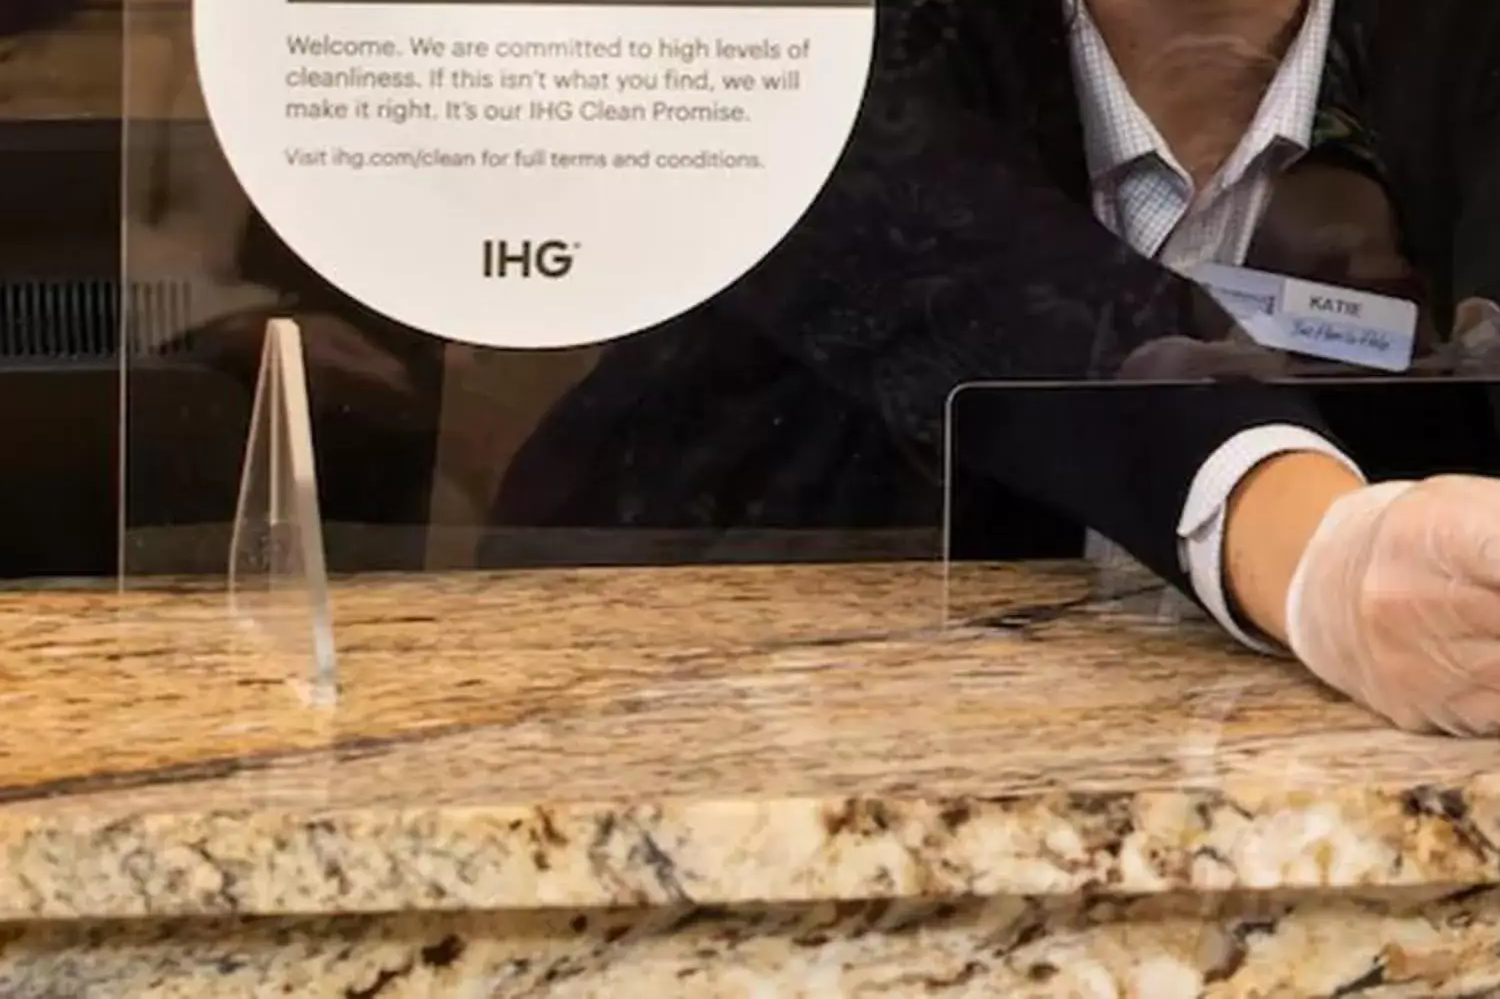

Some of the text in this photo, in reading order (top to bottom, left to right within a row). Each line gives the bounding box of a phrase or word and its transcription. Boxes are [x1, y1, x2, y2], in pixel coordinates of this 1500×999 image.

[286, 34, 810, 66] Welcome. We are committed to high levels of
[285, 66, 422, 89] cleanliness.
[429, 67, 444, 89] If
[451, 68, 493, 89] this
[554, 69, 609, 91] what
[617, 74, 657, 96] you
[664, 68, 715, 95] find,
[722, 74, 756, 91] we
[761, 69, 803, 91] will
[285, 98, 349, 120] make
[355, 99, 370, 120] it
[377, 98, 438, 127] right.
[483, 104, 522, 122] our
[530, 100, 573, 122] IHG
[579, 100, 646, 122] Clean
[652, 101, 750, 123] Promise.
[283, 147, 765, 171] Visit ihg.com/clean for full terms and conditions.
[482, 240, 574, 278] IHG
[1309, 295, 1362, 318] KATIE
